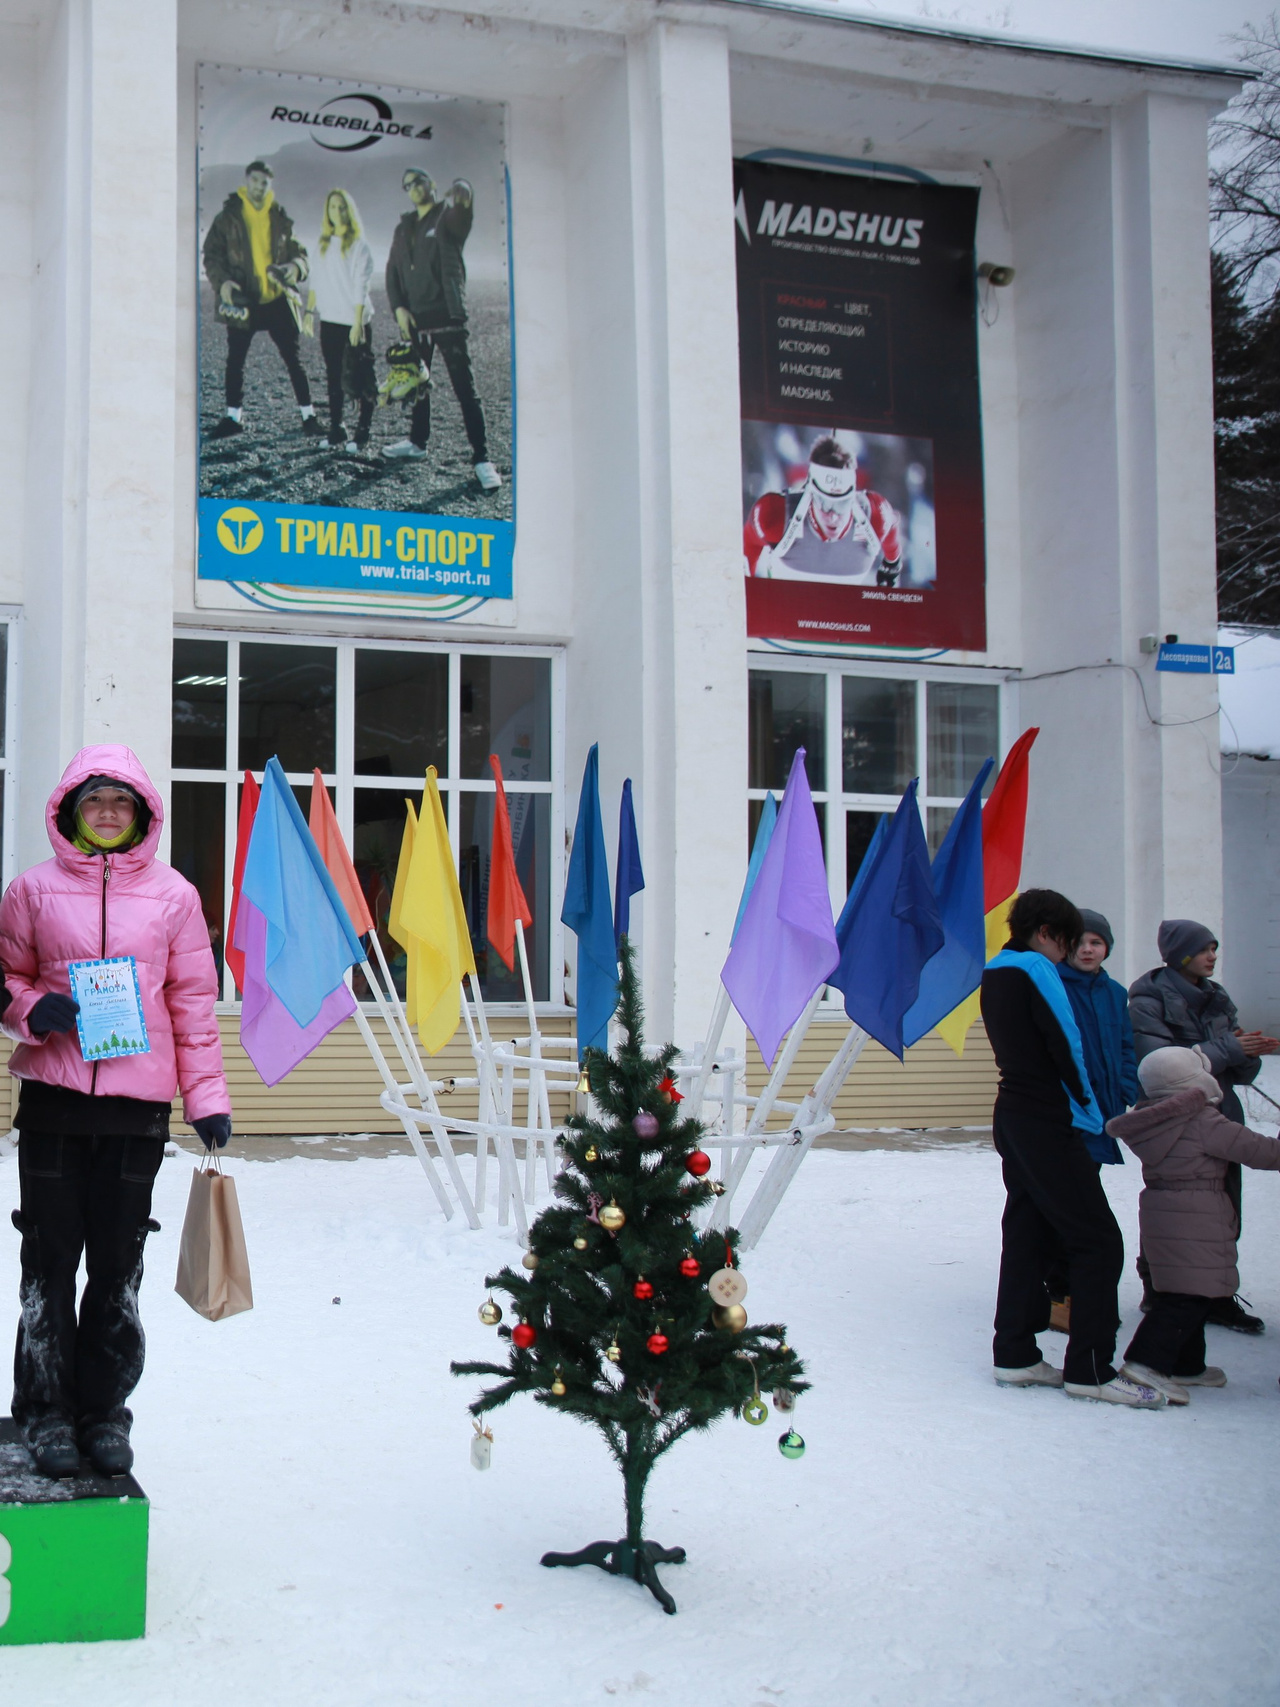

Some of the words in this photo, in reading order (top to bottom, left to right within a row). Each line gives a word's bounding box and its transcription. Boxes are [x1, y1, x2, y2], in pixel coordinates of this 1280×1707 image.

[271, 106, 414, 137] ROLLERBLADE
[756, 199, 924, 249] MADSHUS
[777, 316, 865, 338] ОПРЕДЕЛЯЮЩИЙ
[778, 339, 831, 356] ИСТОРИЮ
[789, 364, 843, 380] НАСЛЕДИЕ
[360, 564, 491, 586] www.trial-sport.ru
[797, 619, 871, 632] WWW.MADSHUS.COM
[84, 984, 127, 997] ГРАМОТА
